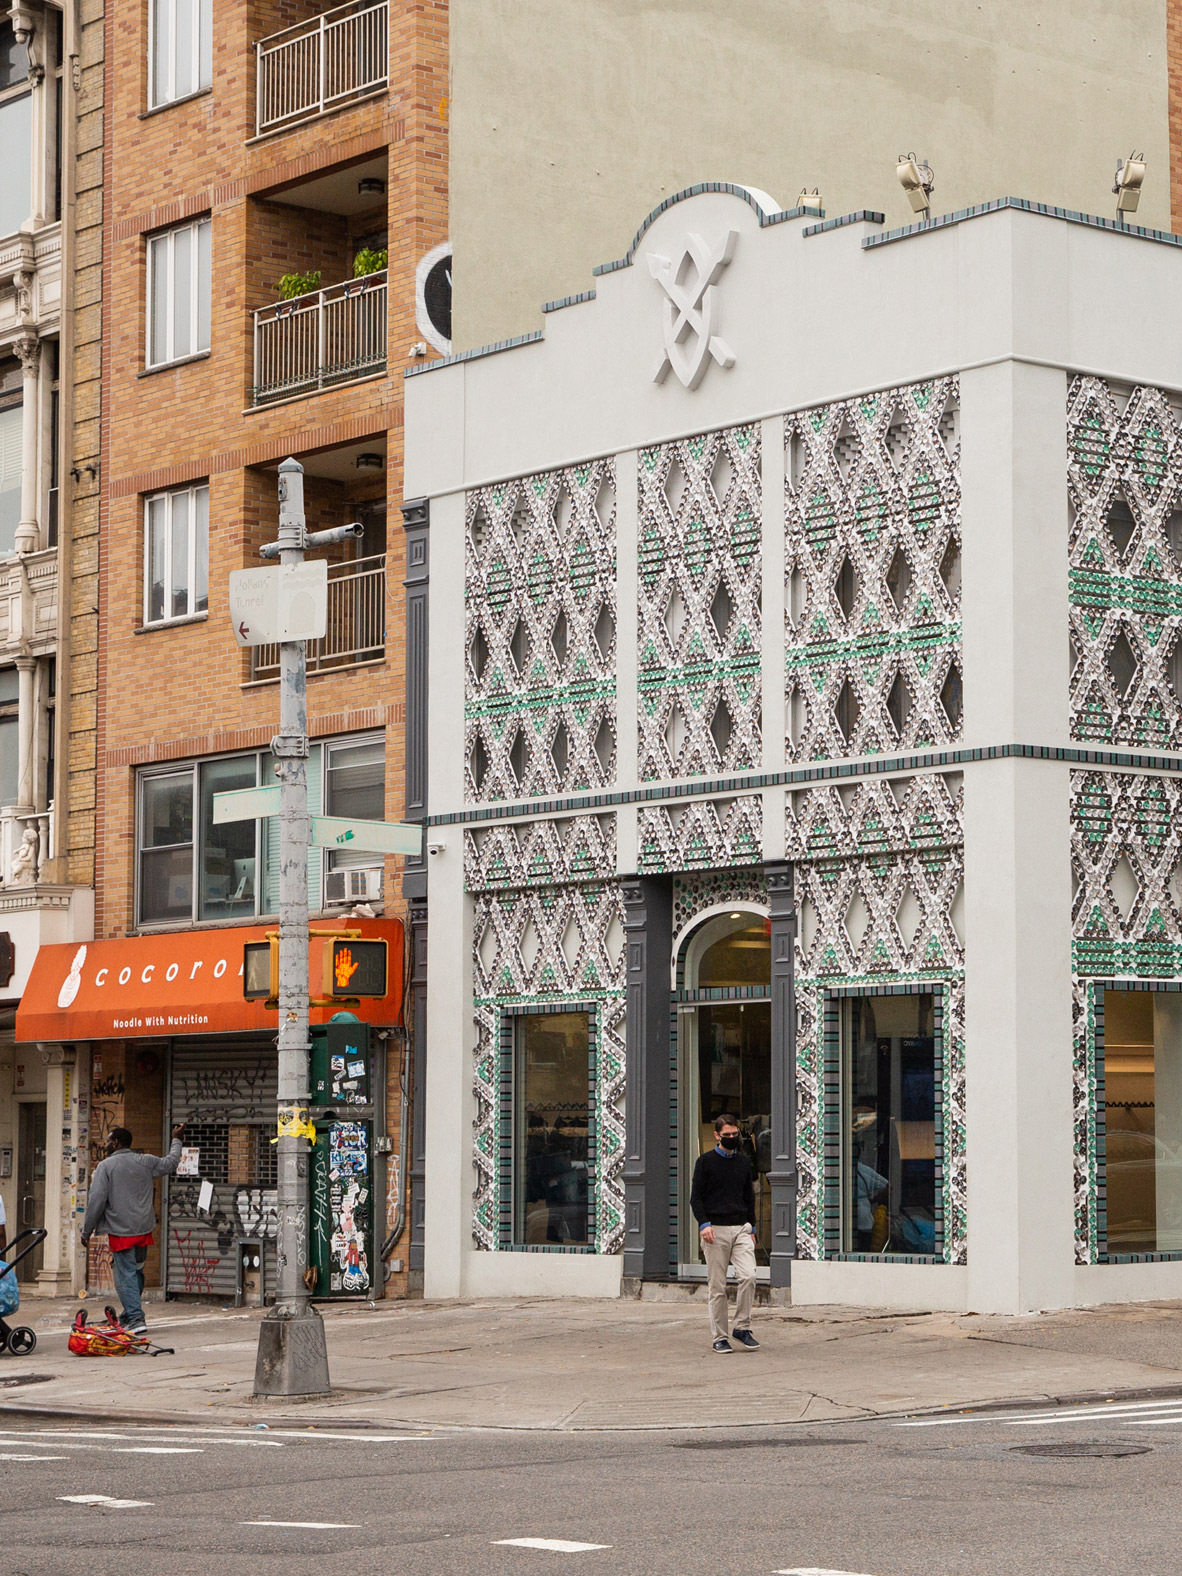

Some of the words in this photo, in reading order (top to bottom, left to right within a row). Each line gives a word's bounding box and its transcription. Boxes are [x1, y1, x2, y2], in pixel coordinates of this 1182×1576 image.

[113, 1017, 142, 1028] Noodle
[145, 1015, 164, 1026] With
[168, 1014, 208, 1025] Nutrition
